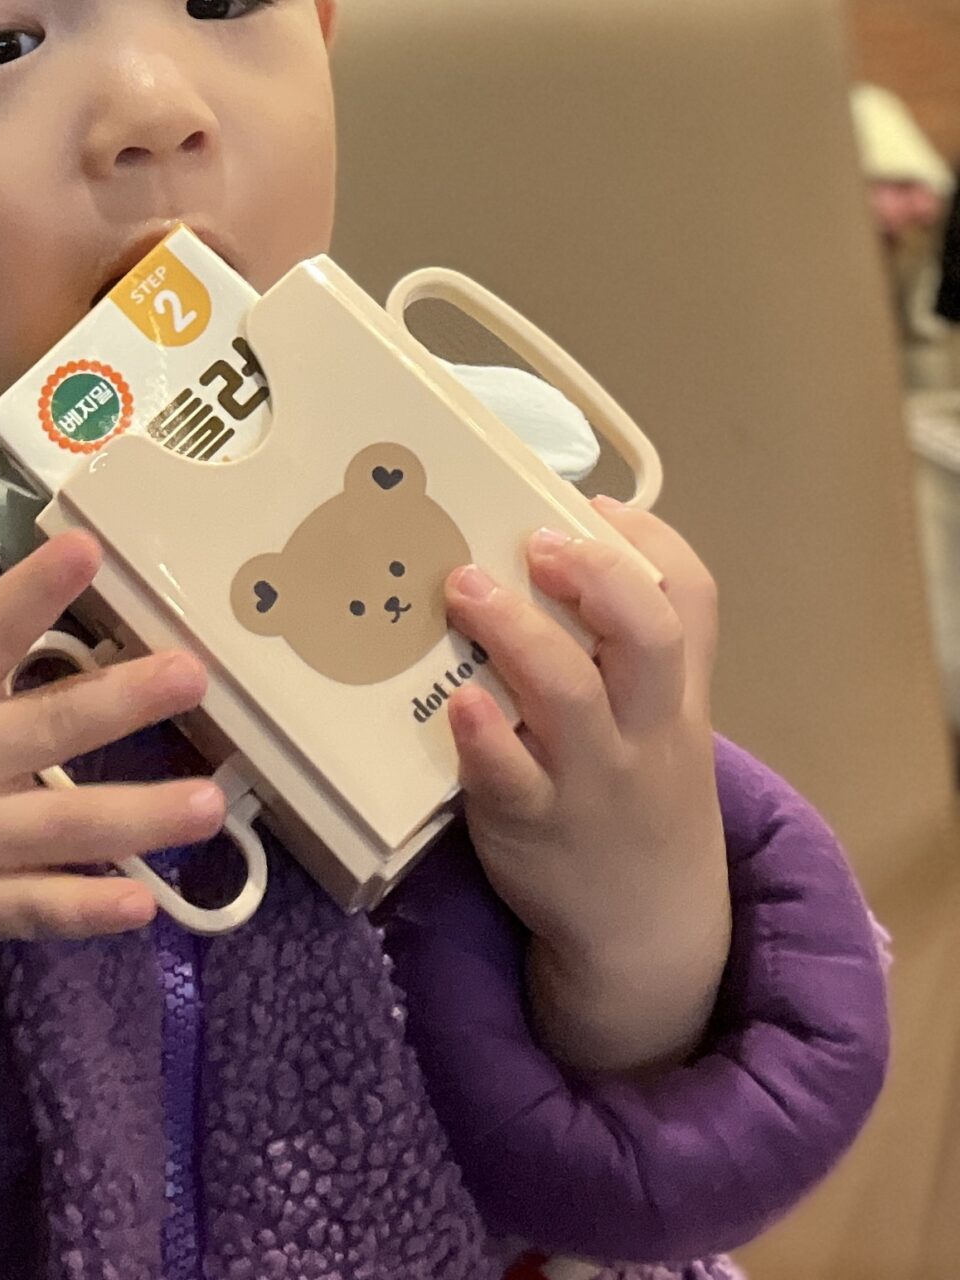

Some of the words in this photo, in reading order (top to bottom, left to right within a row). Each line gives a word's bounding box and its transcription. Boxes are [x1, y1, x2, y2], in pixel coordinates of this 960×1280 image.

[130, 266, 167, 305] STEP
[153, 289, 198, 333] 2
[57, 381, 114, 433] 베지밀
[412, 682, 449, 723] dot
[445, 662, 473, 688] to
